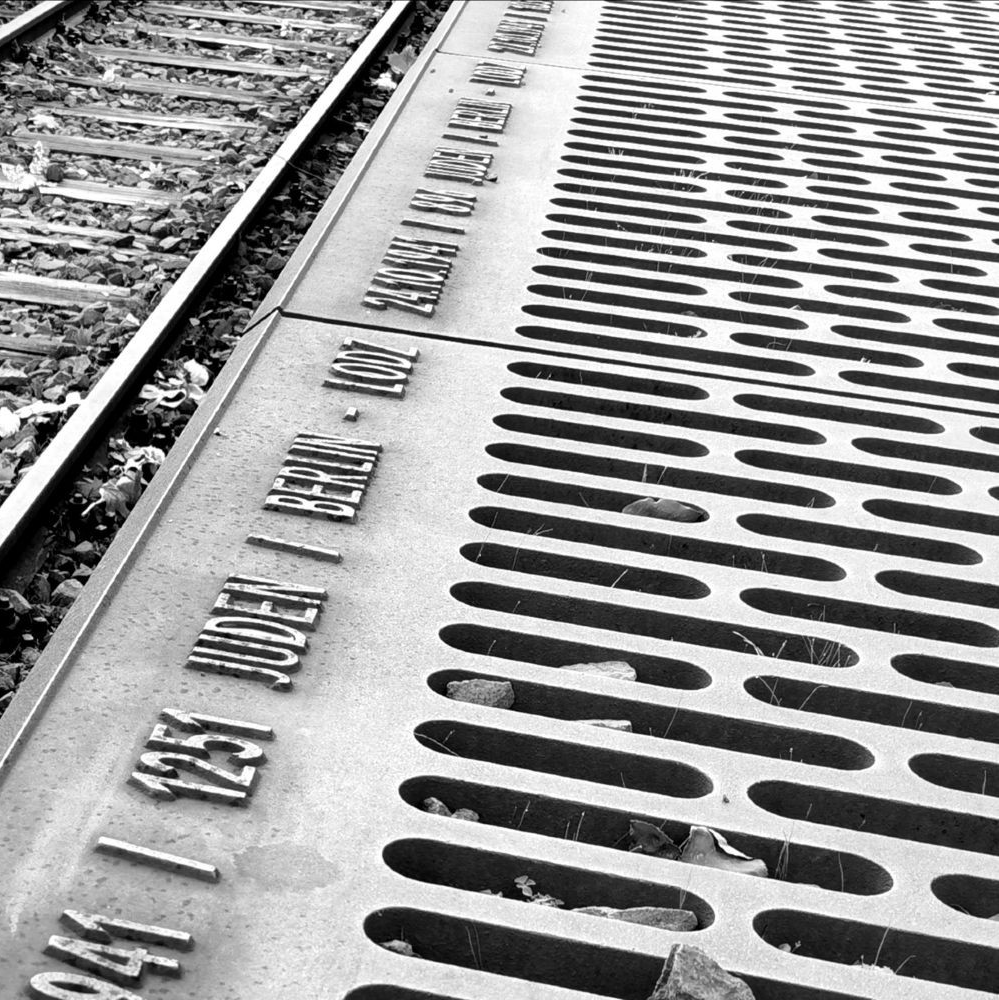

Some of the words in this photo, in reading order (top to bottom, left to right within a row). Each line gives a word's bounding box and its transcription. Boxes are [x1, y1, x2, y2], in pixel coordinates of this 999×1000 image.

[470, 60, 526, 87] LODZ
[448, 97, 511, 133] BERLIN
[425, 146, 493, 185] JUDEN
[410, 187, 476, 216] 896
[361, 236, 459, 317] 24.10.1941
[323, 337, 419, 399] LODZ
[263, 432, 382, 523] BERLIN
[186, 574, 328, 691] JUDEN
[129, 707, 274, 806] 1251
